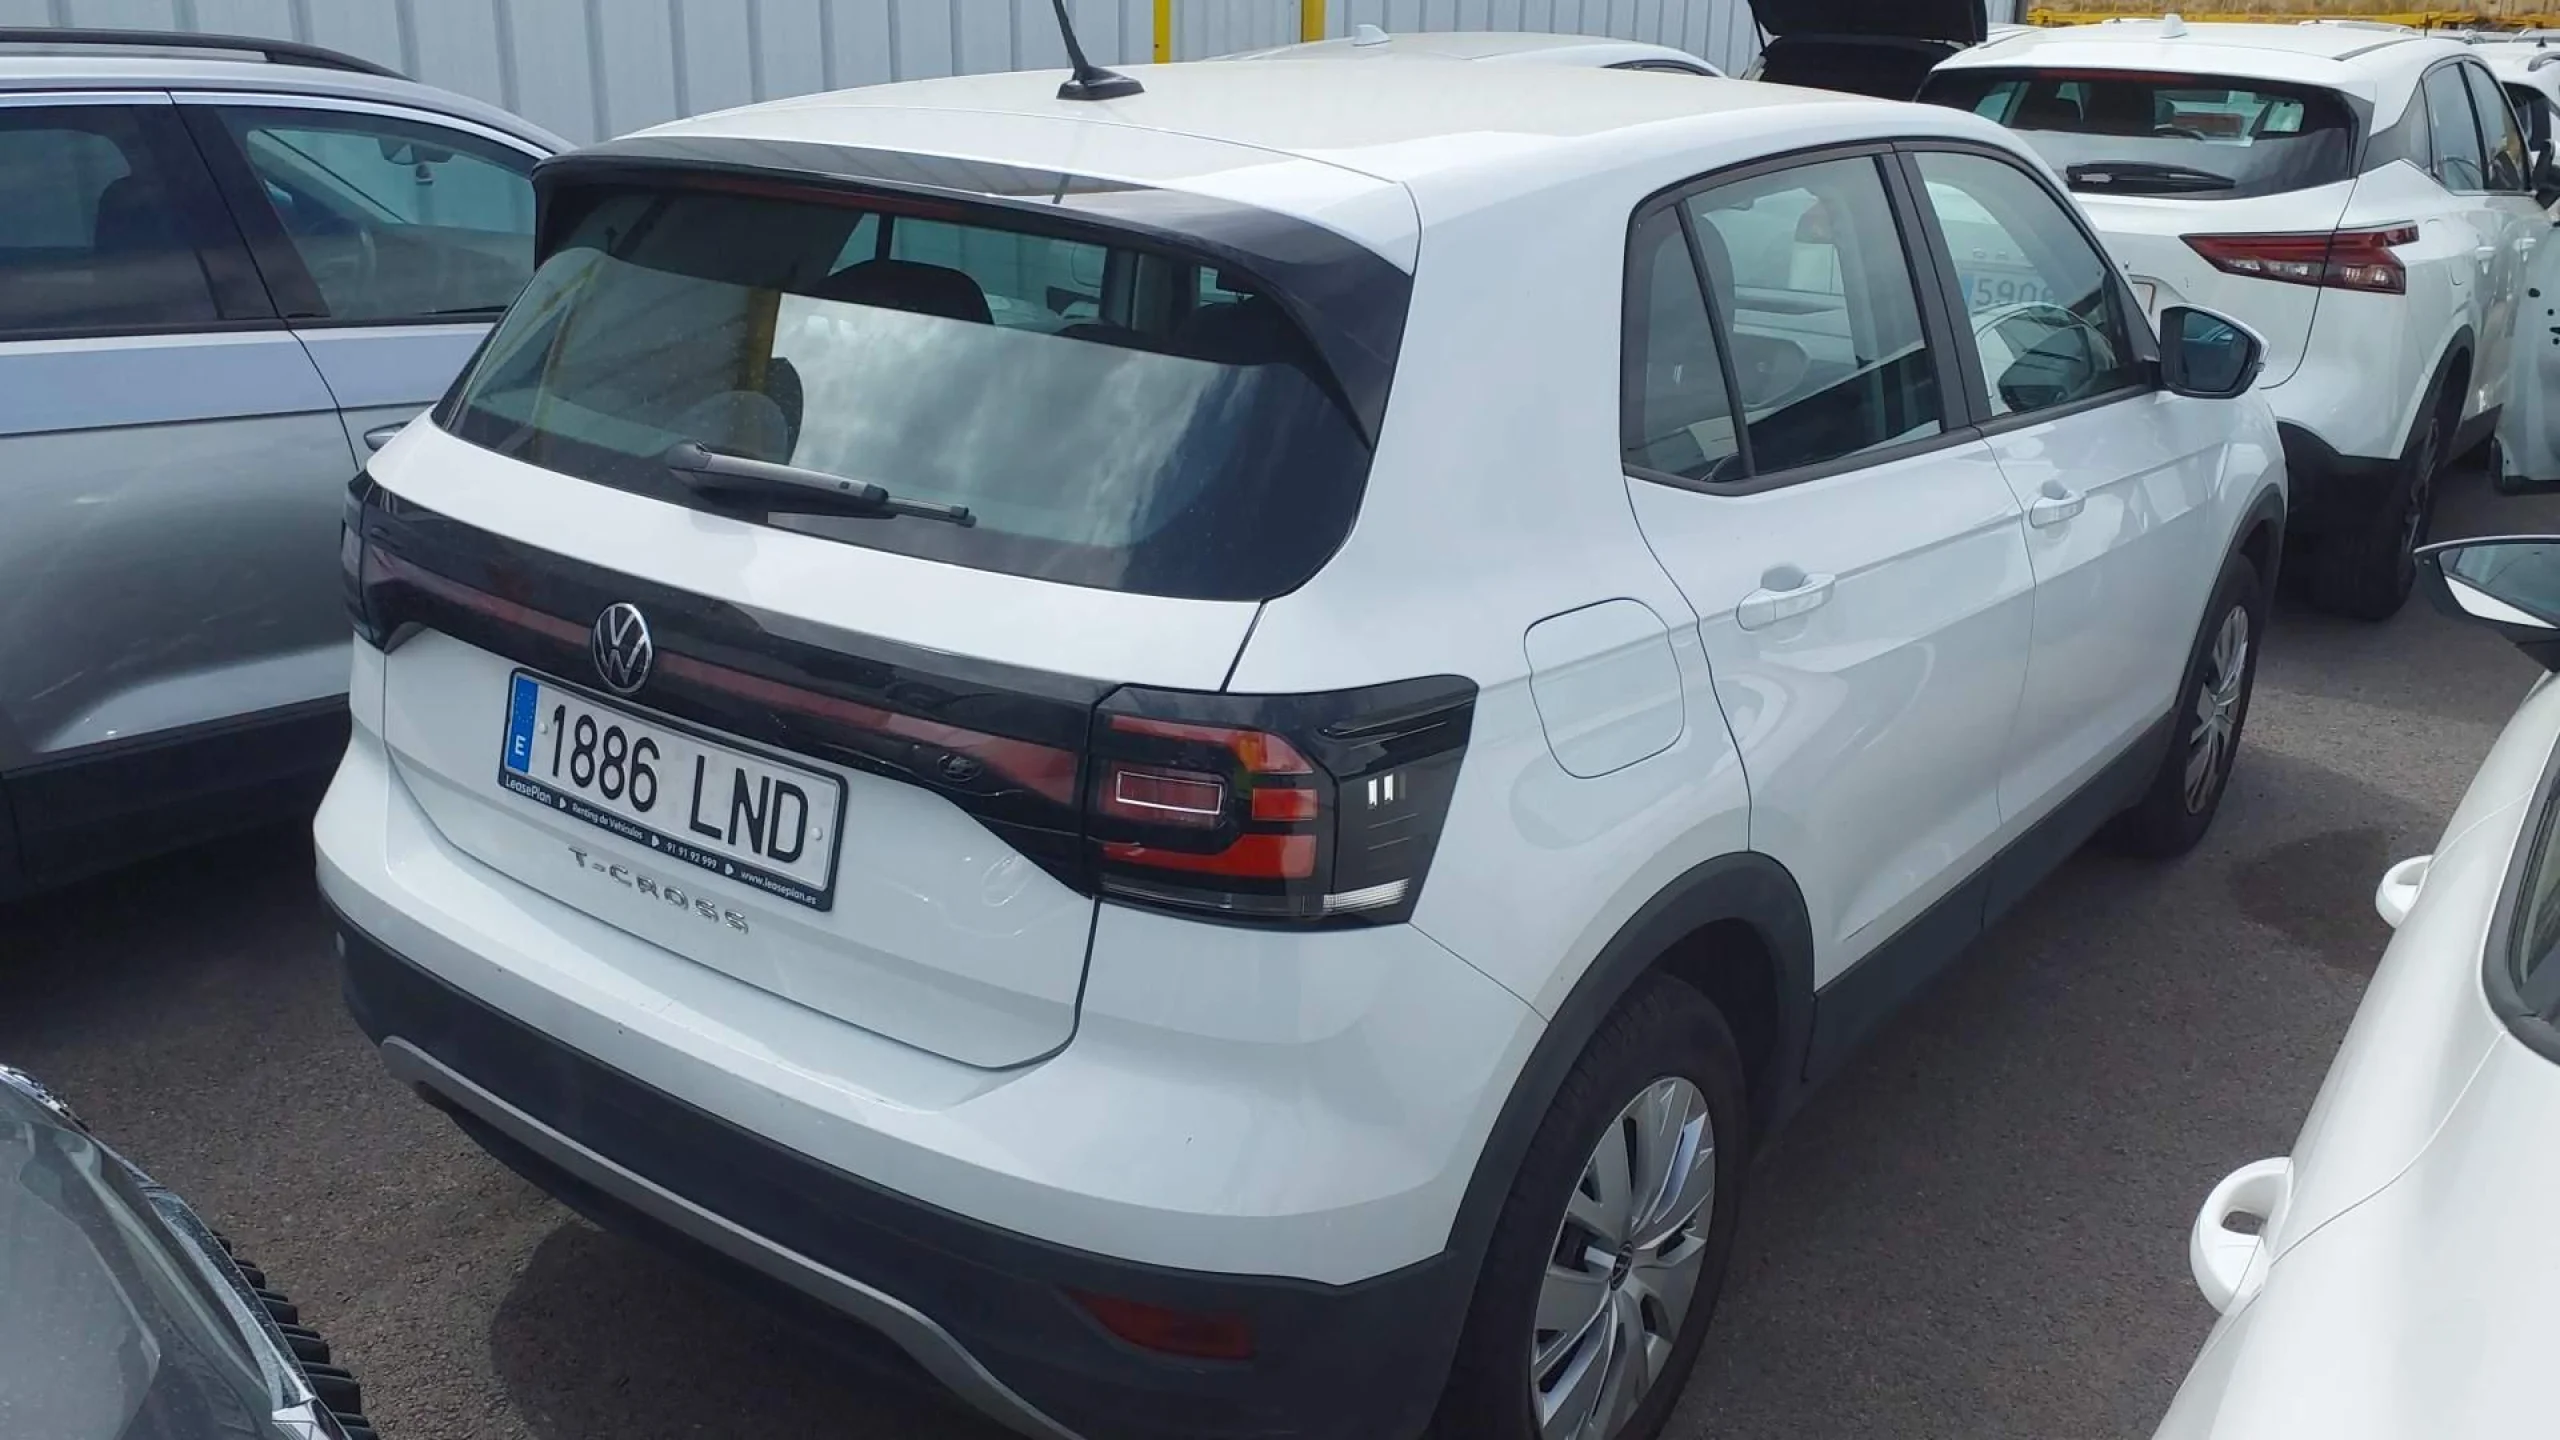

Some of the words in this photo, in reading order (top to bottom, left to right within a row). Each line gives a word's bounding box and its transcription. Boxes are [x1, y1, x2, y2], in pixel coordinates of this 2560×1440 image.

[514, 735, 526, 756] E
[552, 704, 660, 812] 1886
[689, 754, 808, 863] LND
[505, 775, 552, 805] LeasePlan
[667, 842, 676, 853] 91
[678, 846, 688, 857] 91
[690, 851, 700, 862] 92
[702, 855, 717, 868] 999
[740, 871, 817, 904] www.leaseplan.es
[568, 846, 749, 935] T-CROSS
